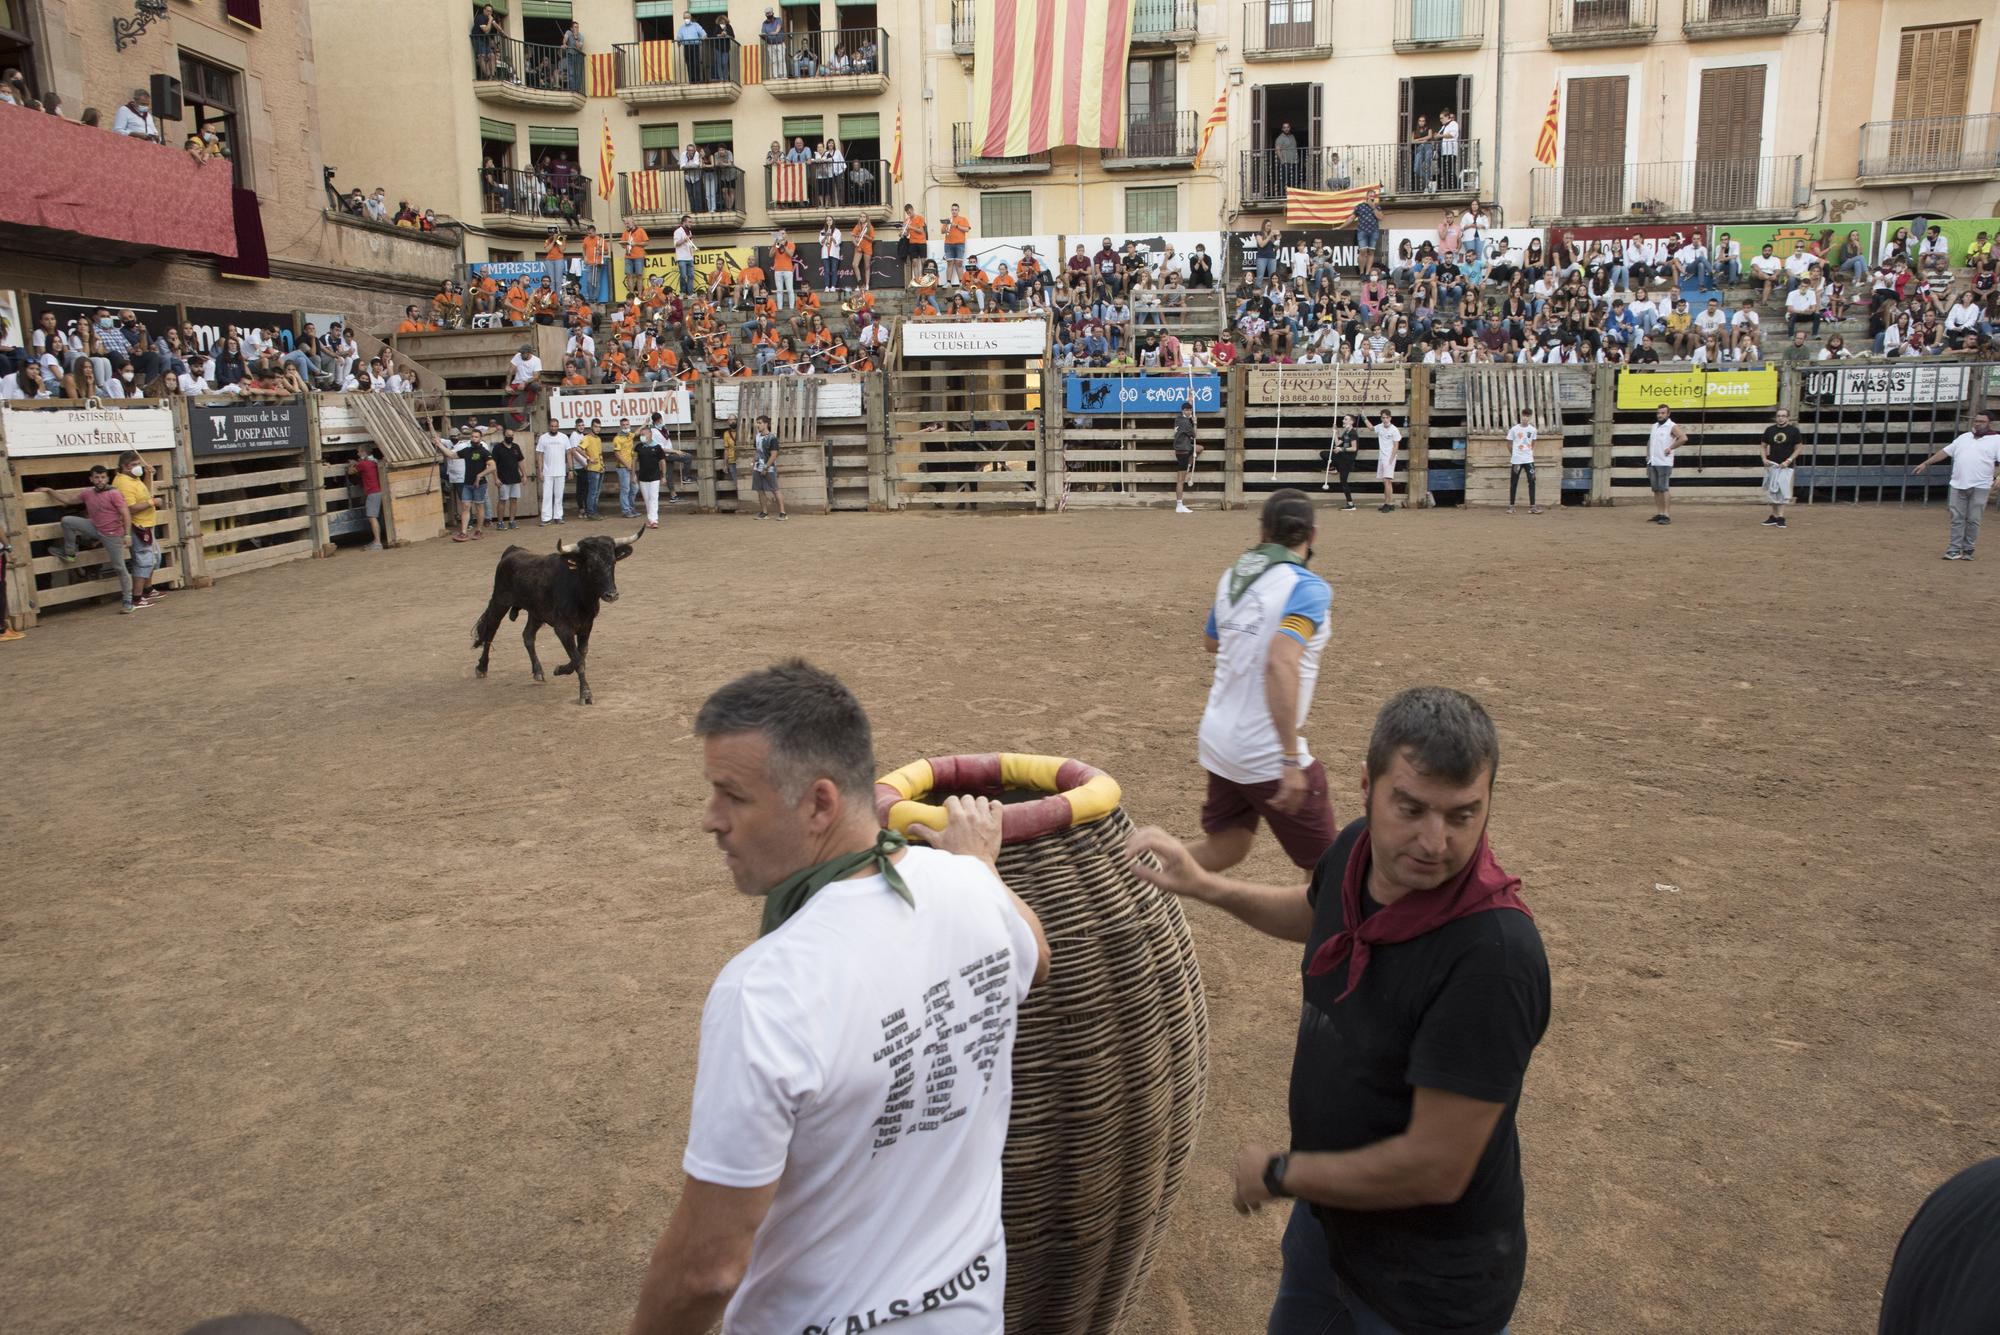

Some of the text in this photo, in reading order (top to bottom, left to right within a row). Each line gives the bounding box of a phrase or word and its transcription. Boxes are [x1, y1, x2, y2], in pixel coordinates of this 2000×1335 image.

[644, 253, 721, 268] CAL MGUET
[919, 331, 965, 339] FUSTERIA
[933, 340, 998, 351] CLUSELLAS
[1262, 377, 1392, 394] CARDENER
[1640, 382, 1750, 398] Meeting Point
[1851, 379, 1906, 393] MASAS
[68, 412, 124, 422] PASTISSERIA
[233, 409, 290, 423] museu de la sal
[560, 400, 603, 419] LICOR
[56, 431, 136, 447] MONTSERRAT
[234, 426, 290, 442] JOSEP ARNAU
